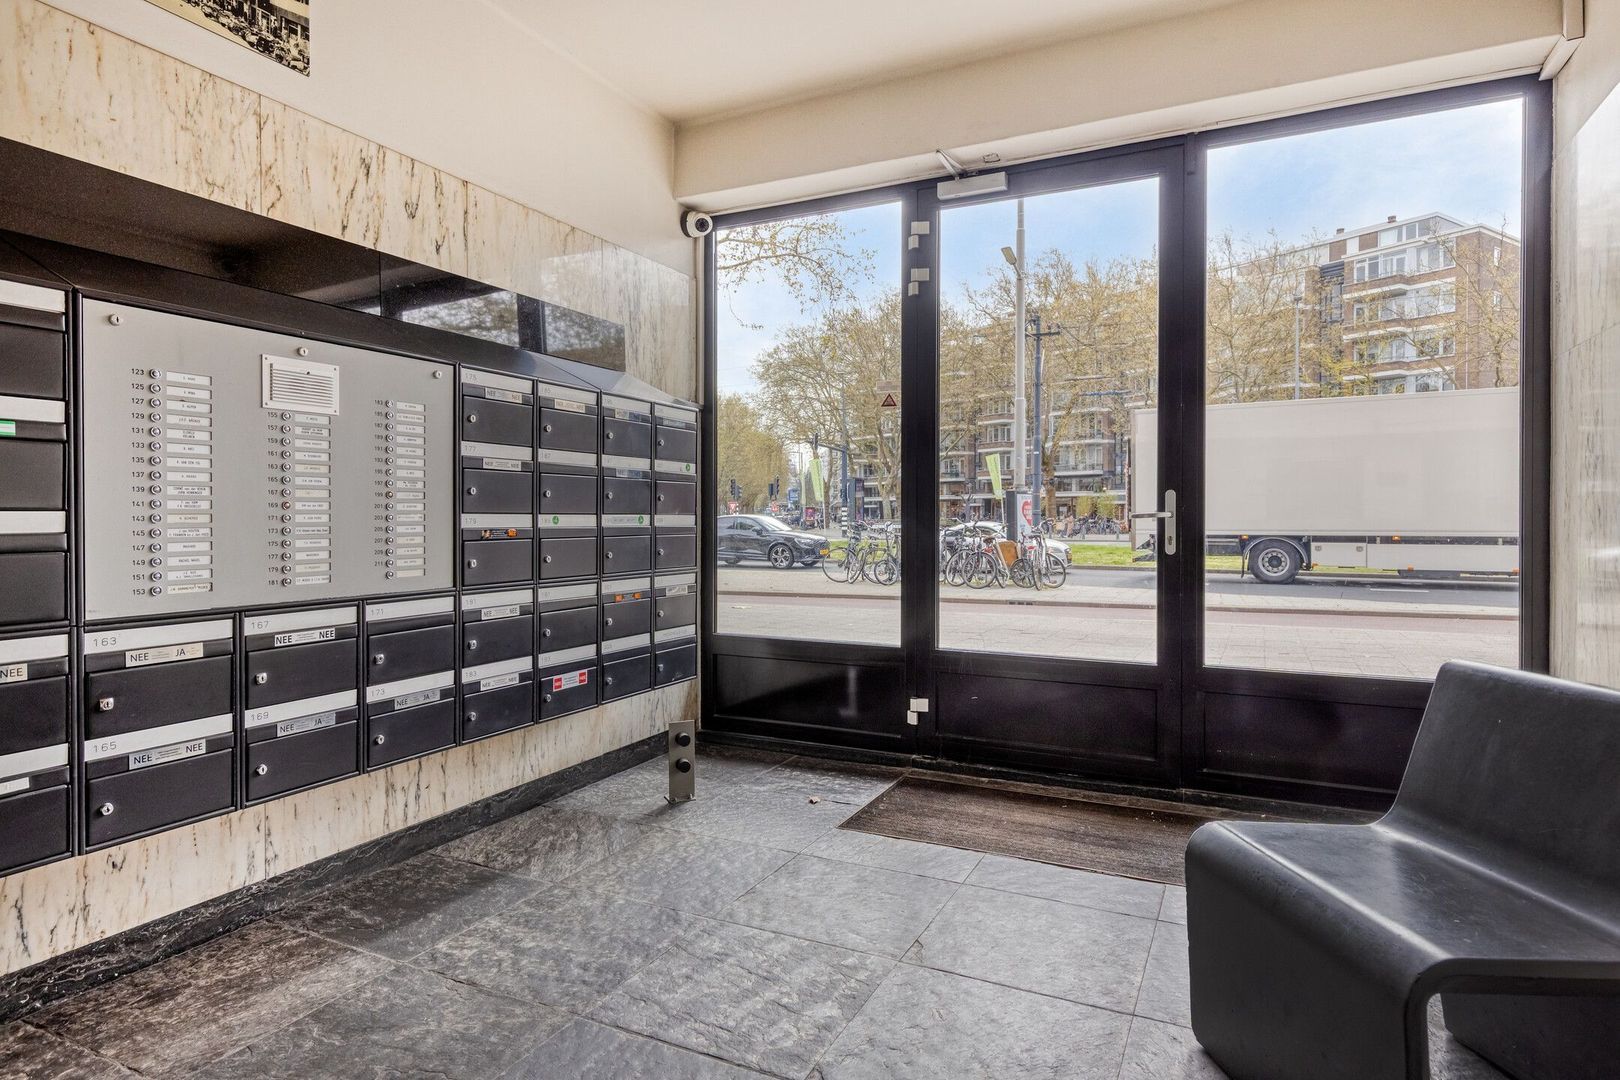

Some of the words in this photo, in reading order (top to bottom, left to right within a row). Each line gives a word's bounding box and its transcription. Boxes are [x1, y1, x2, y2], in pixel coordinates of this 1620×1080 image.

[251, 621, 269, 629] 167
[93, 637, 117, 647] 163
[275, 635, 293, 644] NEE
[319, 630, 335, 639] NEE
[130, 653, 149, 662] NEE
[175, 648, 186, 657] JA
[0, 668, 24, 678] NEE
[371, 688, 385, 696] 173
[251, 712, 269, 721] 169
[279, 724, 294, 733] NEE
[93, 742, 117, 753] 165
[134, 754, 152, 764] NEE
[186, 743, 203, 753] NEE
